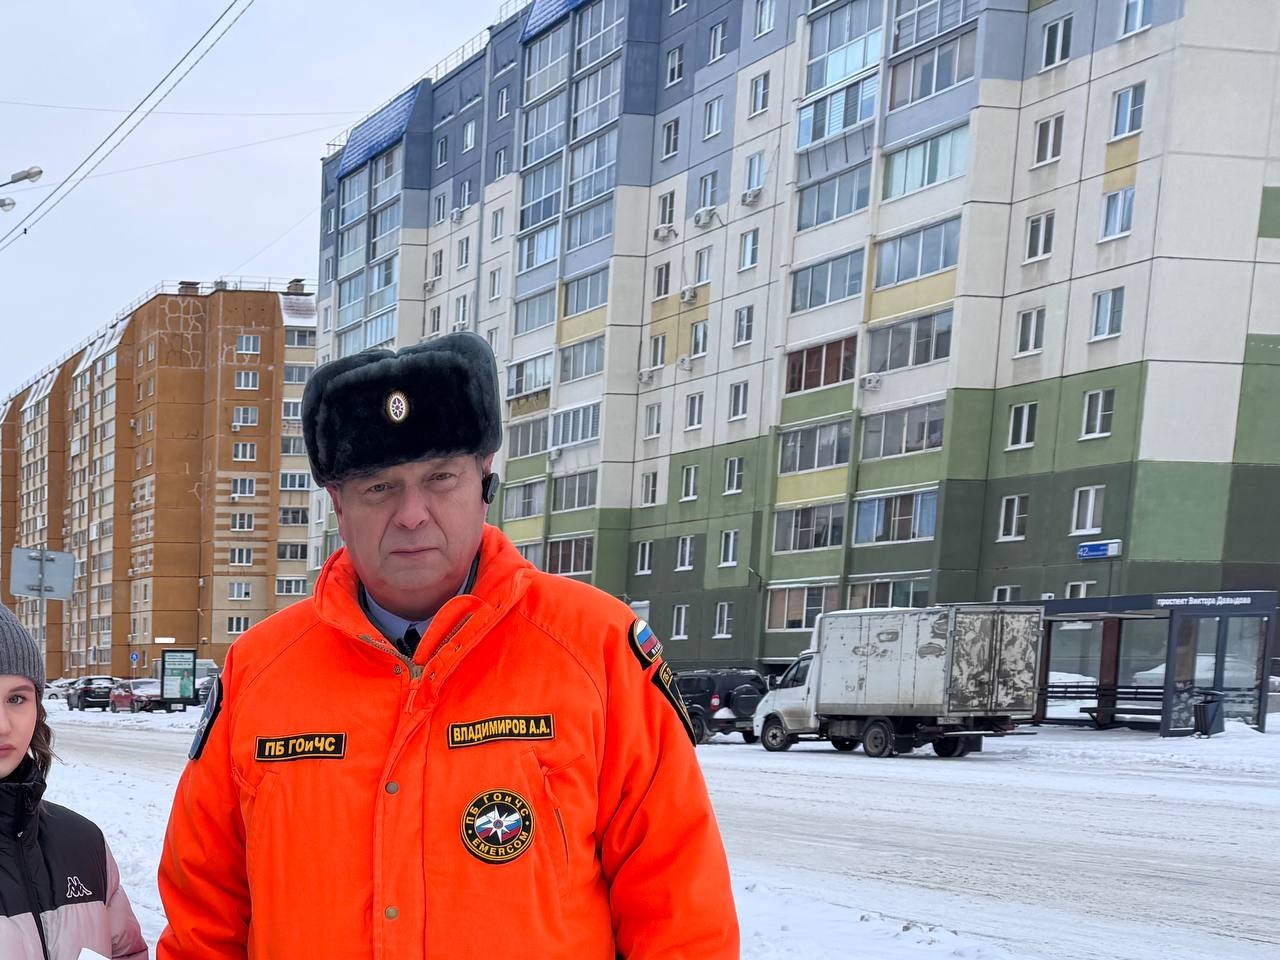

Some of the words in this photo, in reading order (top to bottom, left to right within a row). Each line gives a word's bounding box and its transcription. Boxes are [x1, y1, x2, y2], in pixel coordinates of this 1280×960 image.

[453, 719, 527, 742] ВЛАДИМИРОВ
[529, 718, 551, 735] А.А.
[265, 740, 285, 756] ПБ
[288, 736, 336, 755] ГОиЧС
[466, 806, 479, 825] ПБ
[483, 793, 529, 817] ГОиЧС
[472, 831, 529, 856] EMERCOM
